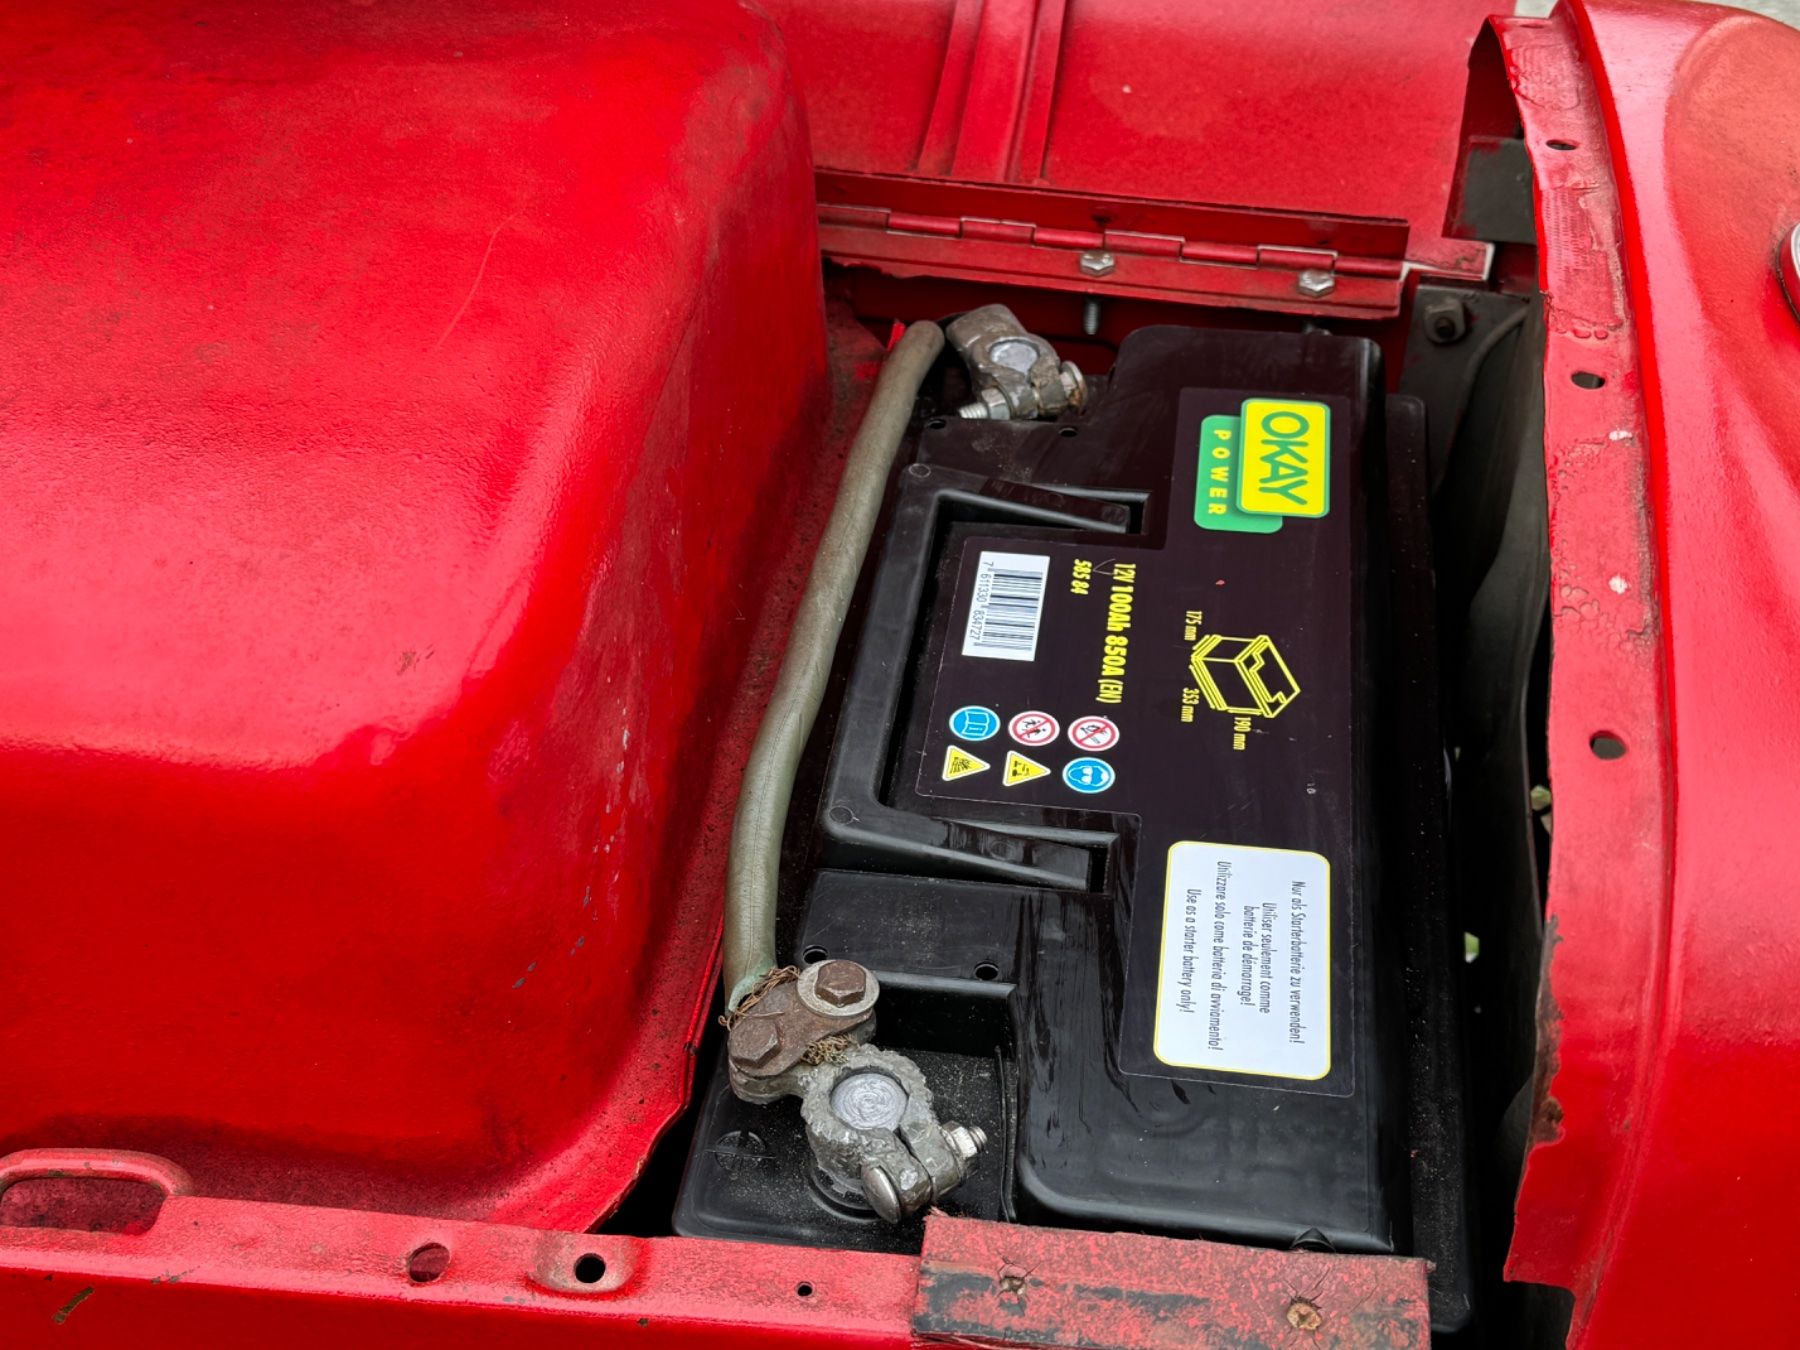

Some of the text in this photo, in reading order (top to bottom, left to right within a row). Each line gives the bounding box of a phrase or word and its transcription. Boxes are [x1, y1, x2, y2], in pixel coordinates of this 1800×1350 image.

[1208, 430, 1232, 515] POWER
[1259, 411, 1310, 505] OKAY
[976, 573, 991, 602] 611330
[1070, 559, 1092, 595] 585 84
[1096, 563, 1136, 704] 12V 100Ah 850A (EN)
[1184, 611, 1202, 641] 175 mm
[1181, 688, 1199, 722] 353 mm
[1233, 717, 1251, 750] 190 mm
[1186, 905, 1197, 915] as
[1187, 889, 1201, 902] Use
[1184, 925, 1198, 953] starter
[1208, 861, 1232, 1051] Utilizzare solo come batteria di avviamento!
[1238, 906, 1259, 1006] batterie de démarrage!
[1177, 956, 1199, 986] battery
[1260, 902, 1277, 1014] Utiliser seulement comme
[1289, 881, 1307, 1044] Nur als Starterbatterie zu verwenden!
[1176, 989, 1194, 1014] only!
